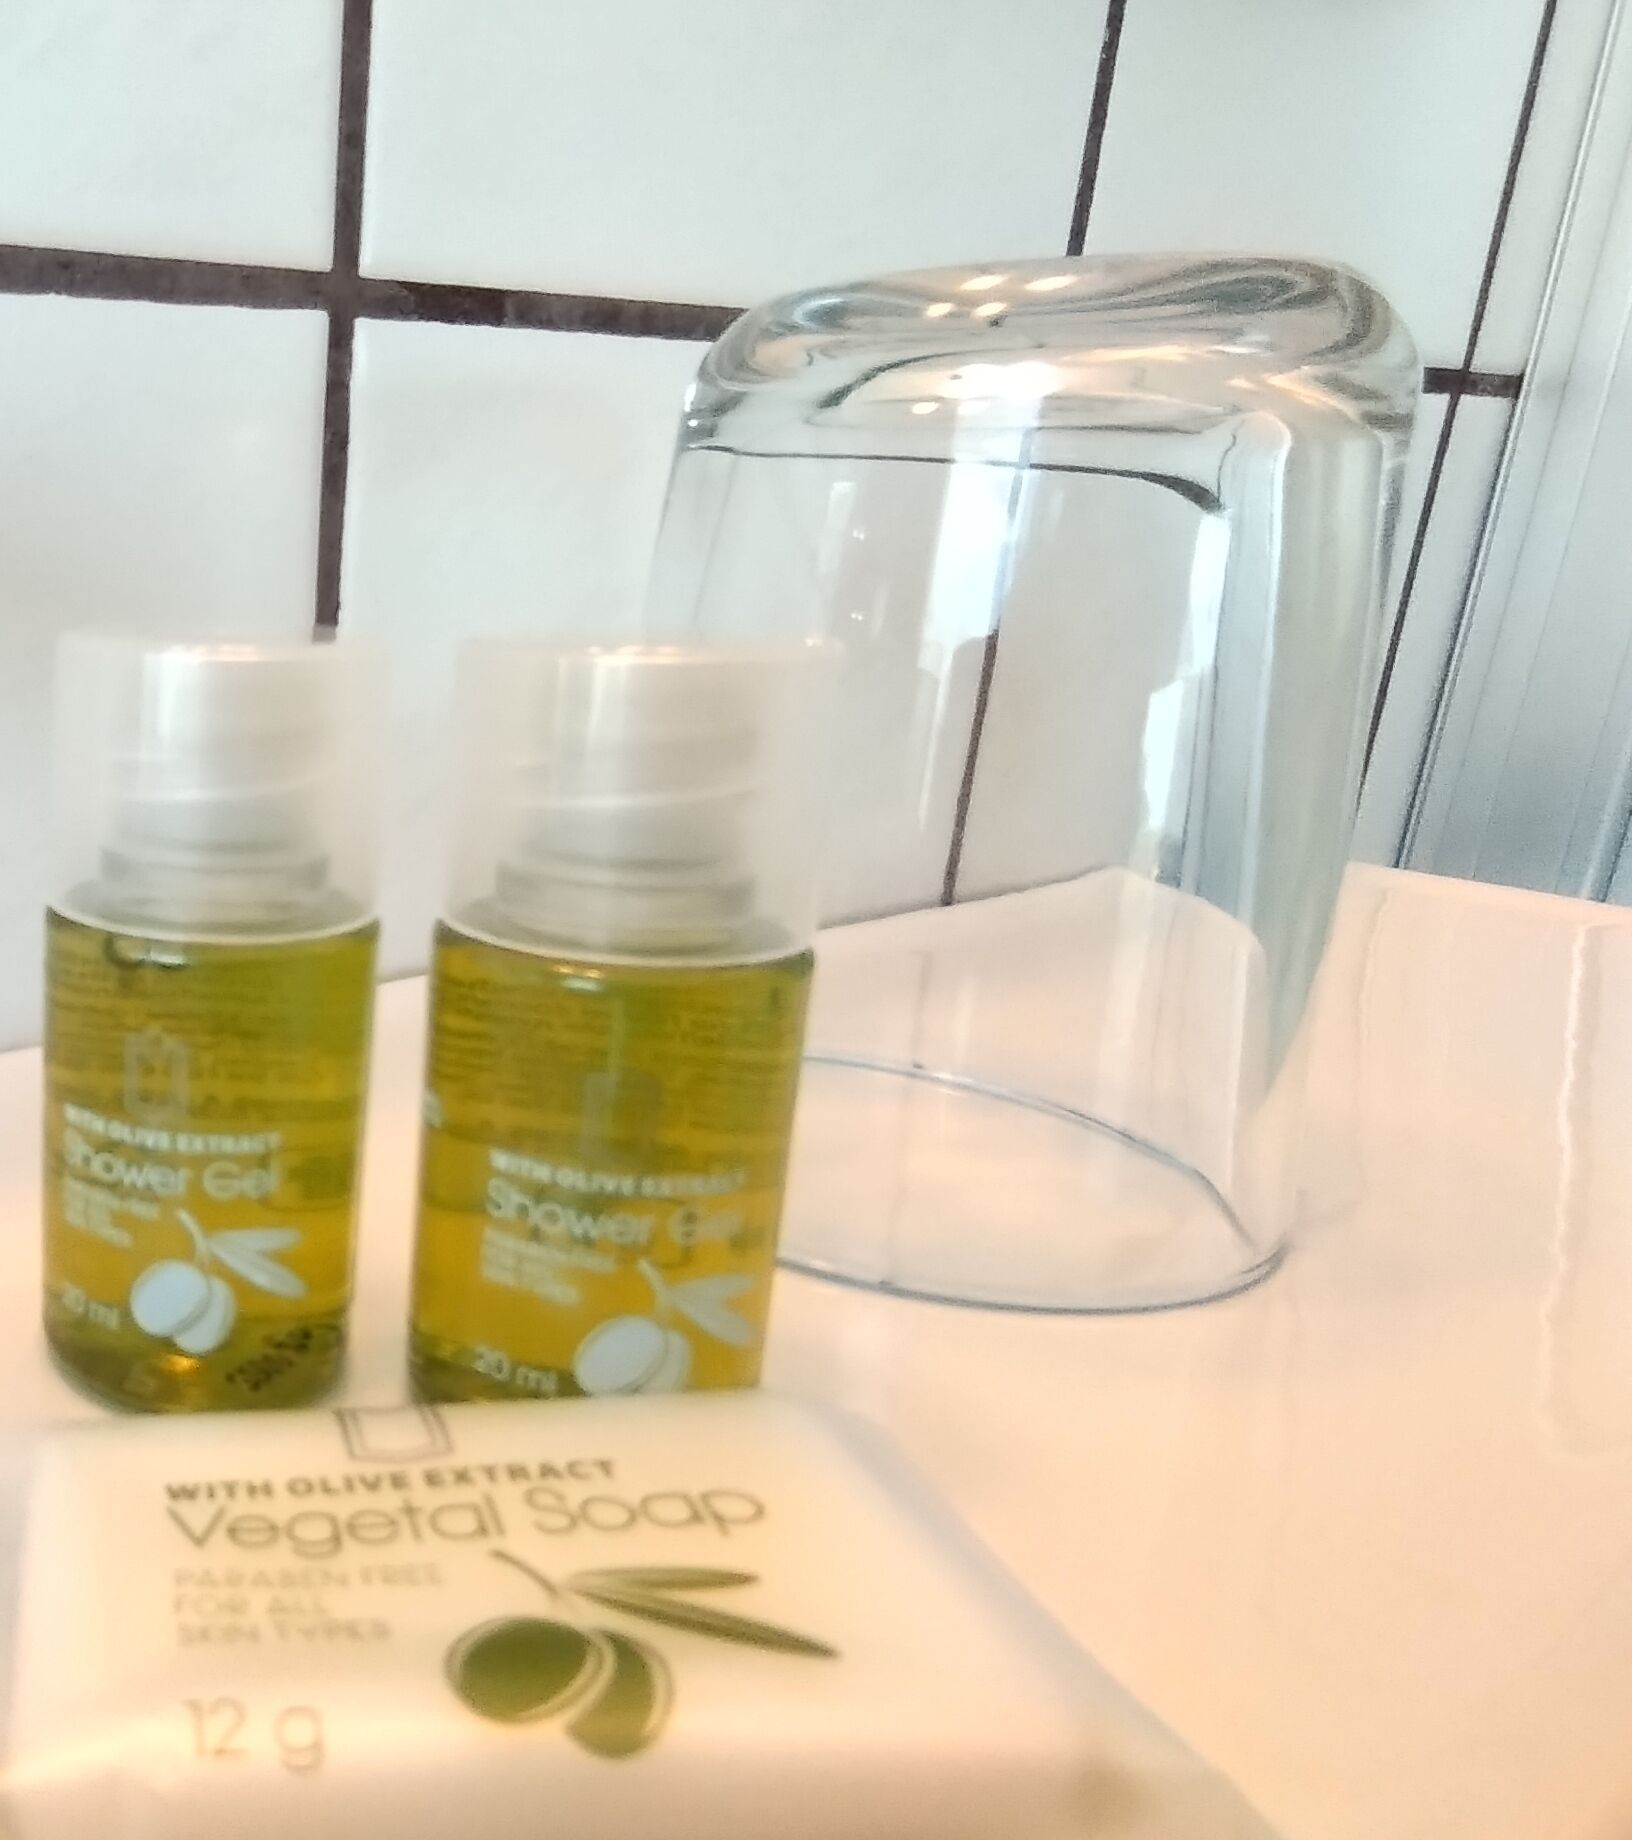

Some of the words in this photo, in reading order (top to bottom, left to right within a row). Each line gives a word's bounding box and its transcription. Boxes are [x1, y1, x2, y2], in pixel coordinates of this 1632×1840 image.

[489, 1149, 553, 1184] WITH
[555, 1164, 636, 1197] OLIVE
[485, 1177, 655, 1247] Shower
[472, 1344, 511, 1382] 20
[514, 1365, 559, 1396] ml
[166, 1480, 274, 1501] WITH
[285, 1470, 411, 1497] OLIVE
[423, 1457, 614, 1488] EXTRACT
[166, 1492, 506, 1559] Vegetal
[523, 1486, 766, 1537] Soap
[174, 1567, 349, 1589] PARABEN
[173, 1593, 250, 1616] FOR
[176, 1620, 260, 1647] SKIN
[271, 1617, 392, 1642] TYPES
[182, 1697, 249, 1761] 12
[273, 1705, 325, 1777] g
